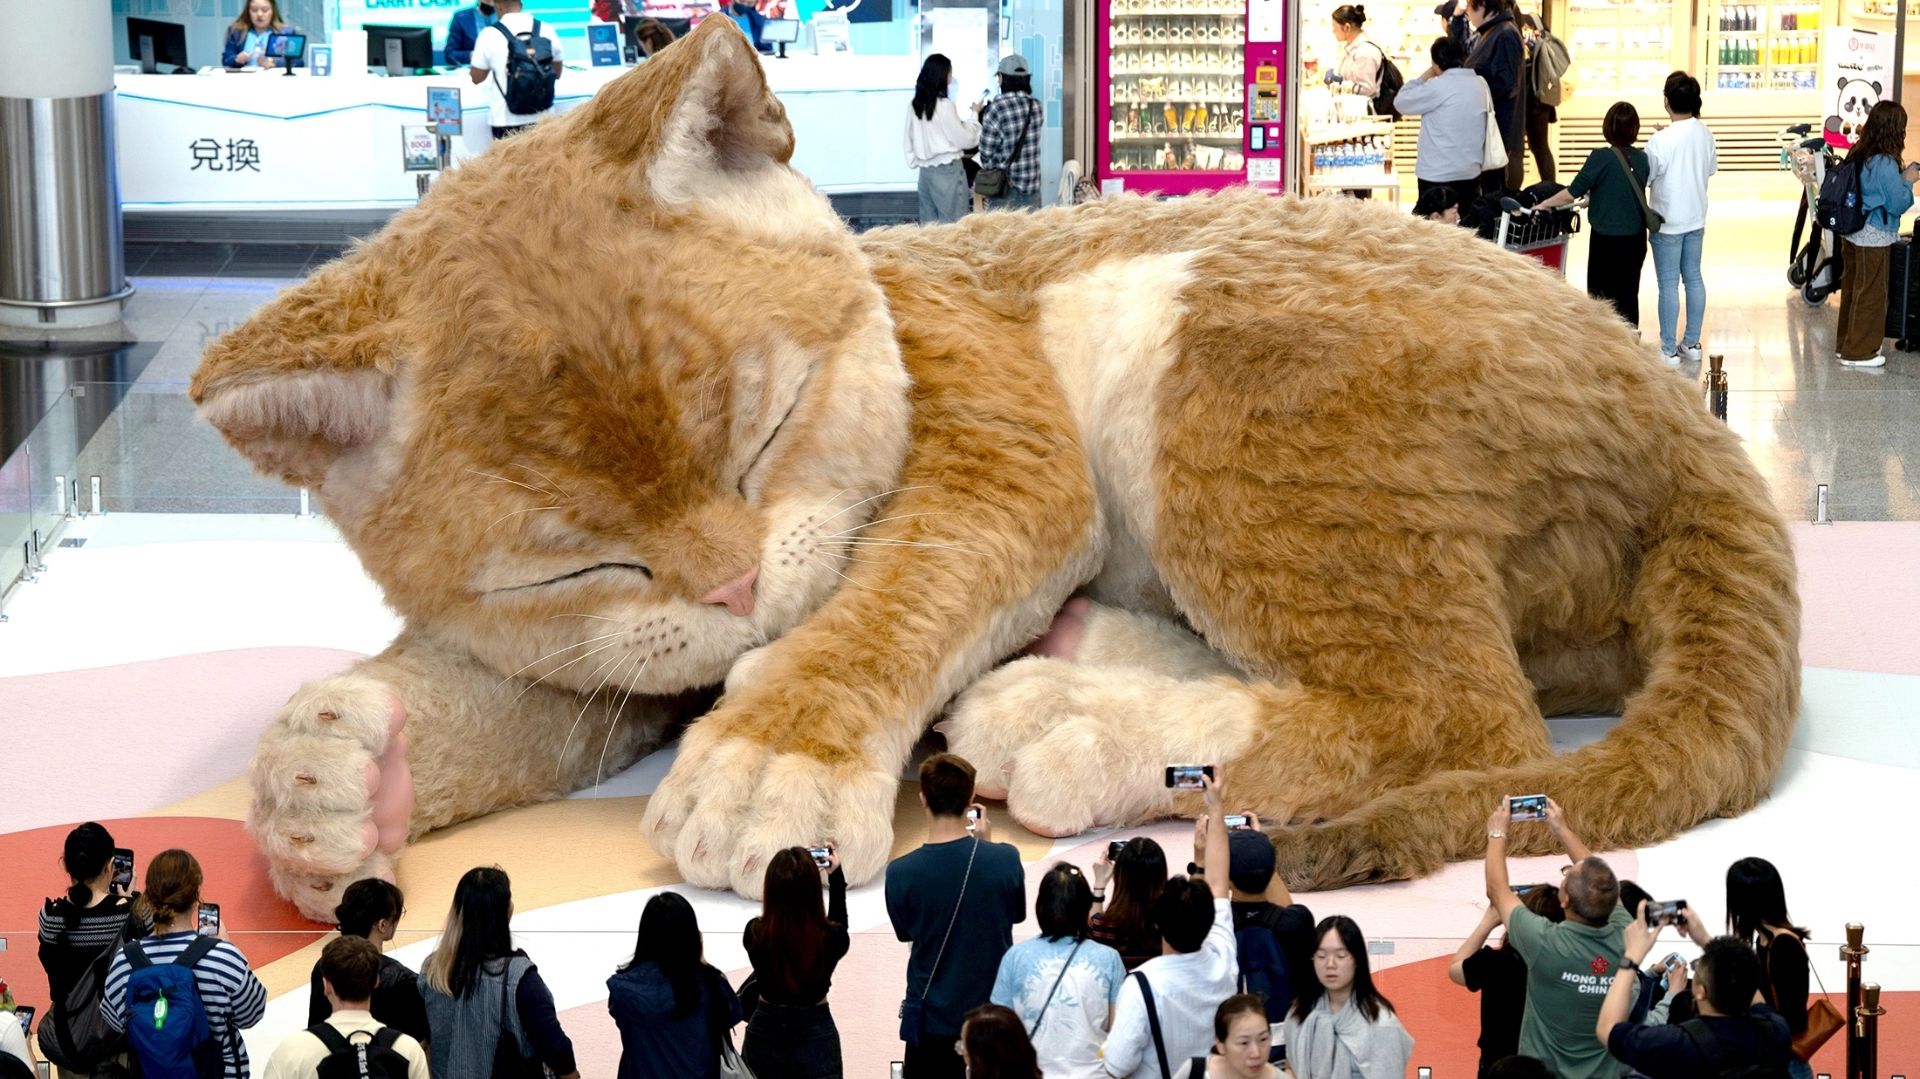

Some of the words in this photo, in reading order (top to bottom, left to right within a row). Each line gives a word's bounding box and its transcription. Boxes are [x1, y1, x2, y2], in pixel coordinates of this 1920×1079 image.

[189, 138, 260, 172] 兌換
[1561, 972, 1597, 984] HONG
[1578, 984, 1608, 994] CHIN
